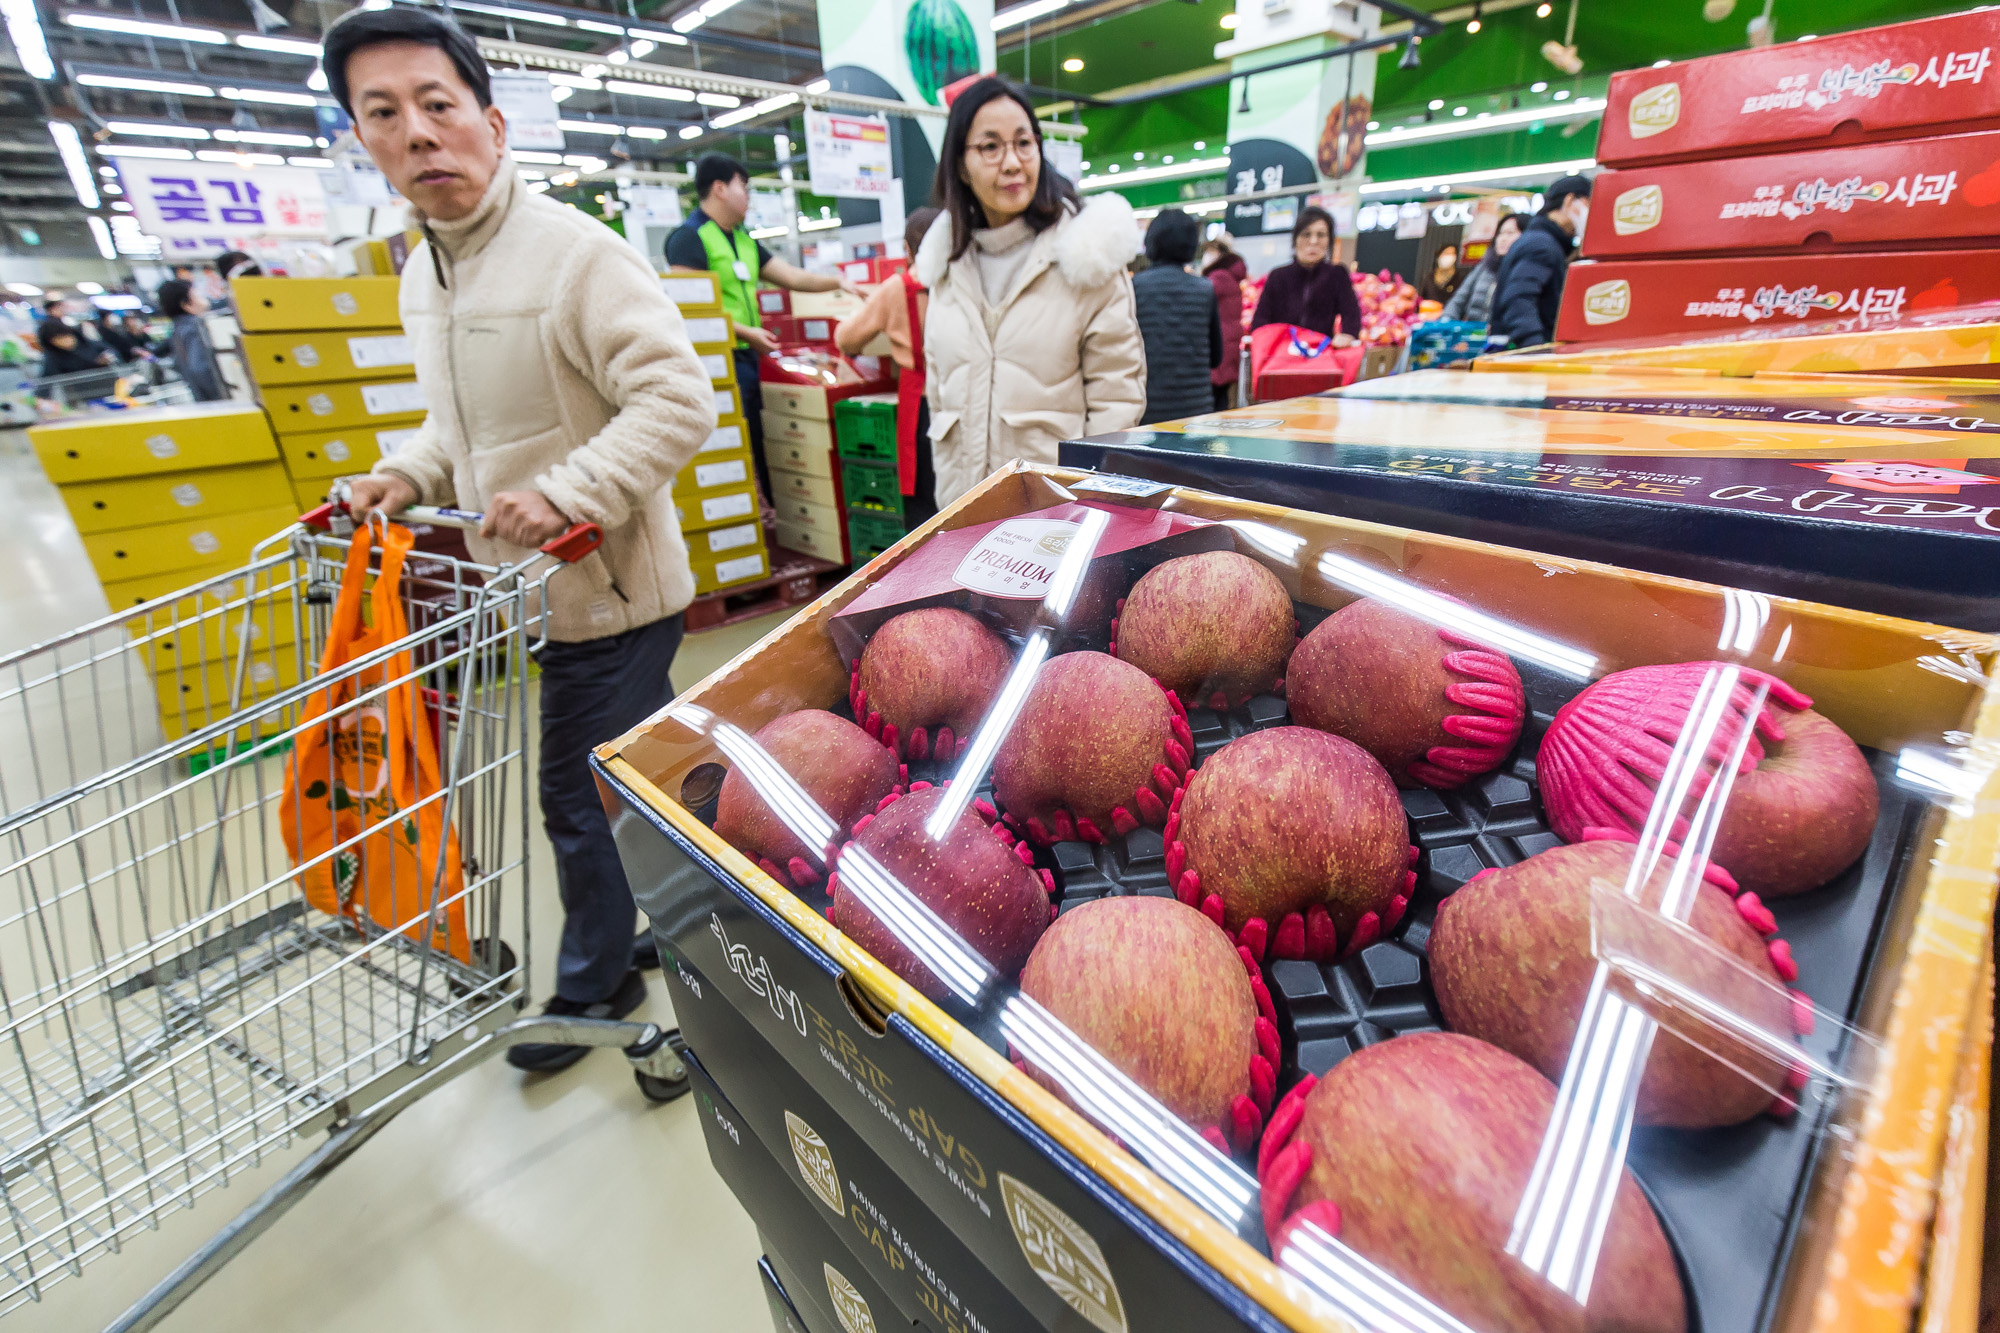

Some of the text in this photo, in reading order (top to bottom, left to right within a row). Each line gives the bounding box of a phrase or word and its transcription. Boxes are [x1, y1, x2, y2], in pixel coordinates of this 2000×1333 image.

[1914, 46, 1992, 89] 사과
[1234, 164, 1284, 196] 과일
[1884, 171, 1958, 207] 사과
[151, 177, 265, 224] 곶감
[1838, 286, 1906, 320] 사과
[1388, 460, 1687, 497] GAP 고당도
[1626, 474, 1702, 486] 재배한
[993, 536, 1015, 546] FOODS
[1013, 534, 1033, 543] FRESH
[971, 548, 1057, 585] PREMIUM
[805, 1001, 988, 1190] GAP 고당도
[854, 1077, 930, 1158] 칼슘농법으로
[933, 1152, 991, 1219] 특허받은
[849, 1179, 889, 1233] 특허받은
[891, 1226, 961, 1313] 칼슘농법으로
[851, 1204, 905, 1271] GAP
